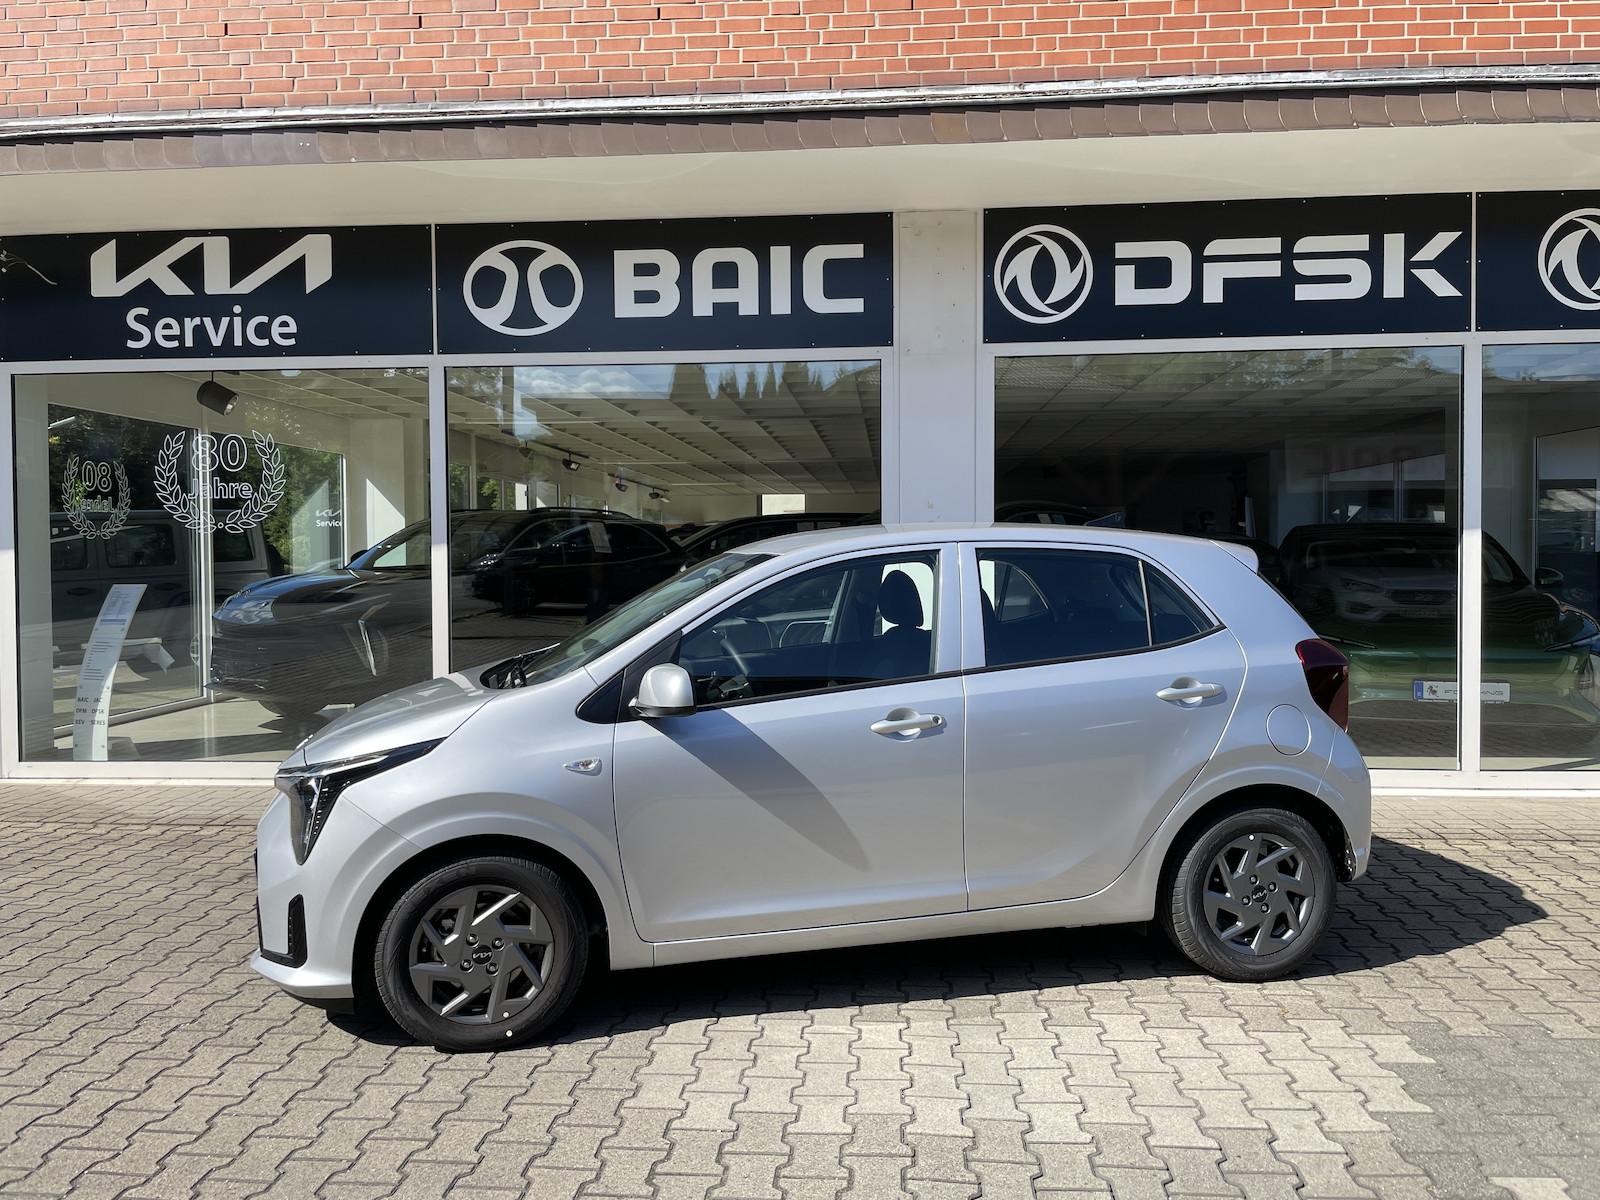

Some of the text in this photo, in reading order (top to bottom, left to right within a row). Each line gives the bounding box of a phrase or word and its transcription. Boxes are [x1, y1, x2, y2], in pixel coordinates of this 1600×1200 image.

[90, 234, 333, 298] KIA
[613, 243, 865, 319] BAIC
[1114, 231, 1463, 306] DFSK
[125, 304, 298, 349] Service
[191, 433, 248, 472] 80
[188, 476, 253, 500] Jahre
